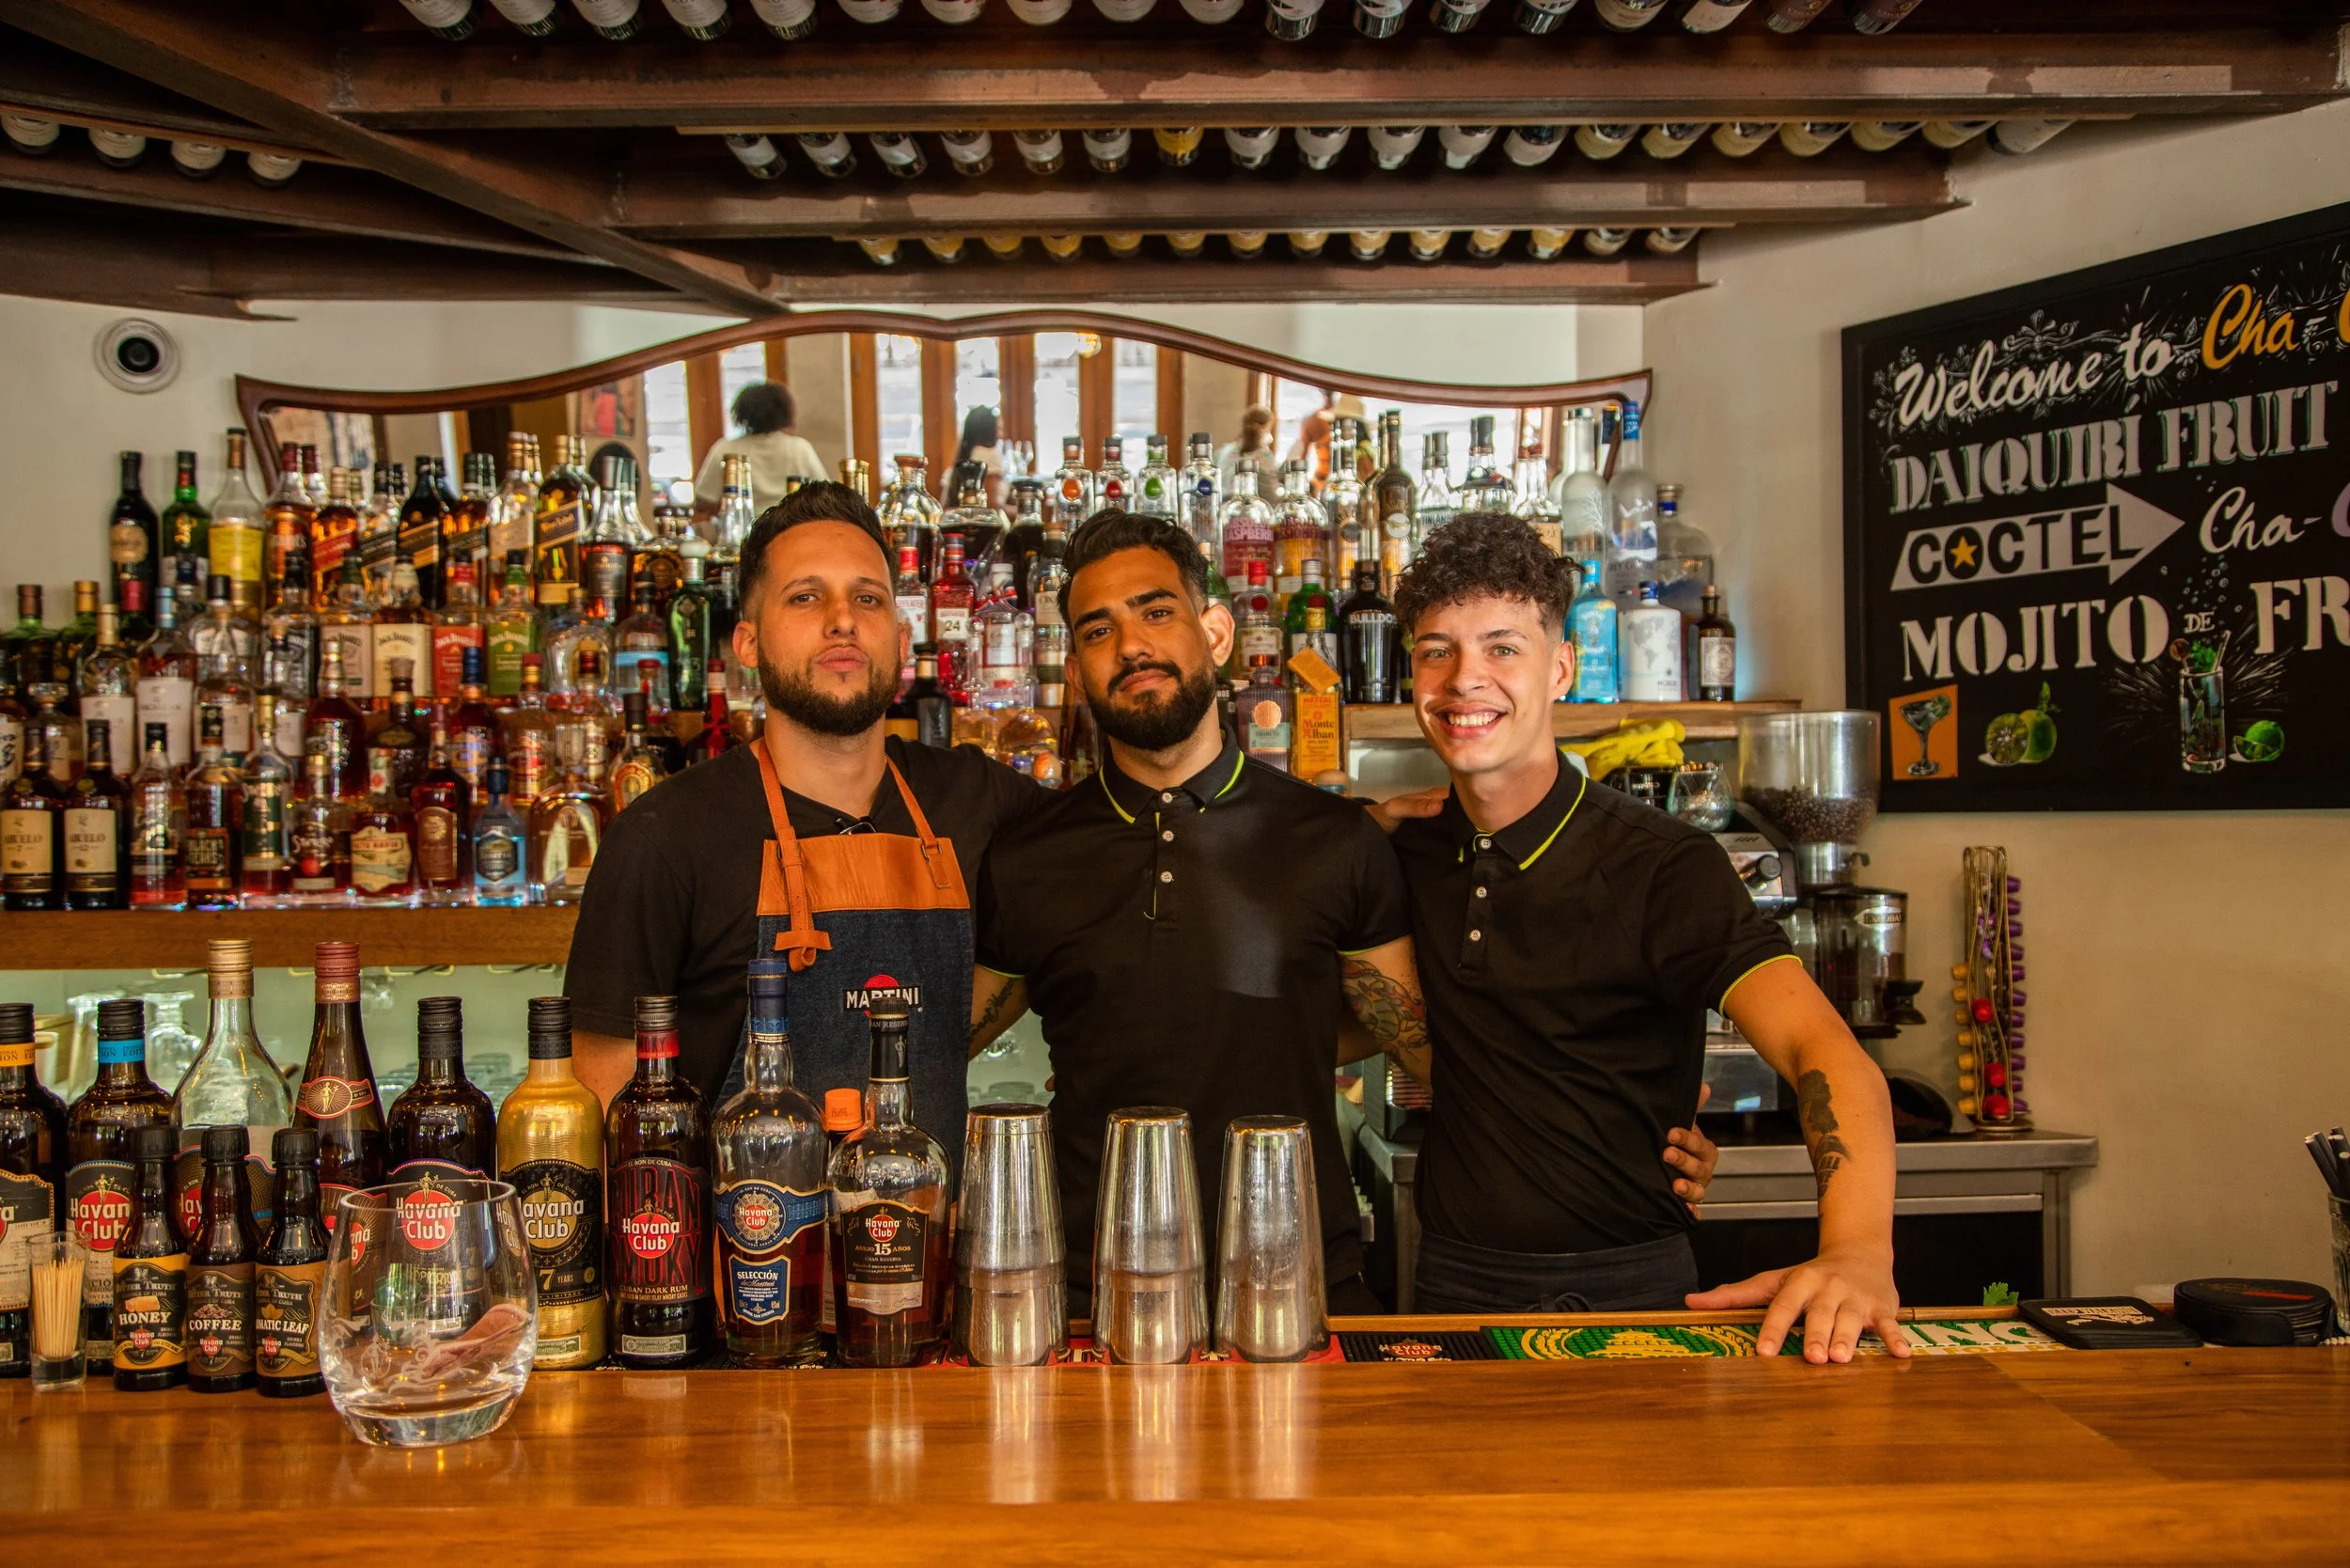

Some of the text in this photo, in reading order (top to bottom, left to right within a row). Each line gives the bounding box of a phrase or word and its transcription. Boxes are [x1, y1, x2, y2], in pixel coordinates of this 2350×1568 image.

[1894, 283, 2350, 426] Welcome to Cha-
[1888, 380, 2339, 513] DAIQUIRÍ FRUIT
[1908, 504, 2144, 586] COCTEL
[944, 619, 961, 632] 24
[1900, 594, 2170, 682] MOJITO
[2183, 611, 2216, 635] DE
[656, 1159, 673, 1168] CUBA
[444, 1185, 457, 1199] CUBA
[527, 1183, 539, 1191] RON
[396, 1198, 464, 1219] Havana
[739, 1207, 773, 1217] Havana
[623, 1218, 681, 1234] Havana
[745, 1217, 766, 1227] Club
[865, 1217, 901, 1229] Havana
[81, 1221, 126, 1241] Club
[406, 1221, 447, 1240] Club
[525, 1219, 570, 1240] Club
[872, 1228, 893, 1238] Club
[634, 1234, 667, 1251] Club
[874, 1243, 892, 1256] 15
[540, 1269, 574, 1291] 7 YEARS
[737, 1269, 779, 1280] SELECCIÓN
[144, 1280, 176, 1291] TRUTH
[619, 1285, 643, 1294] CUBAN
[645, 1286, 668, 1294] DARK
[670, 1284, 688, 1294] RUM
[272, 1288, 304, 1301] TRUTH
[119, 1311, 171, 1326] HONEY
[189, 1319, 242, 1331] COFFEE
[283, 1320, 309, 1334] LEAF
[130, 1331, 155, 1340] Havana
[265, 1345, 277, 1354] Club
